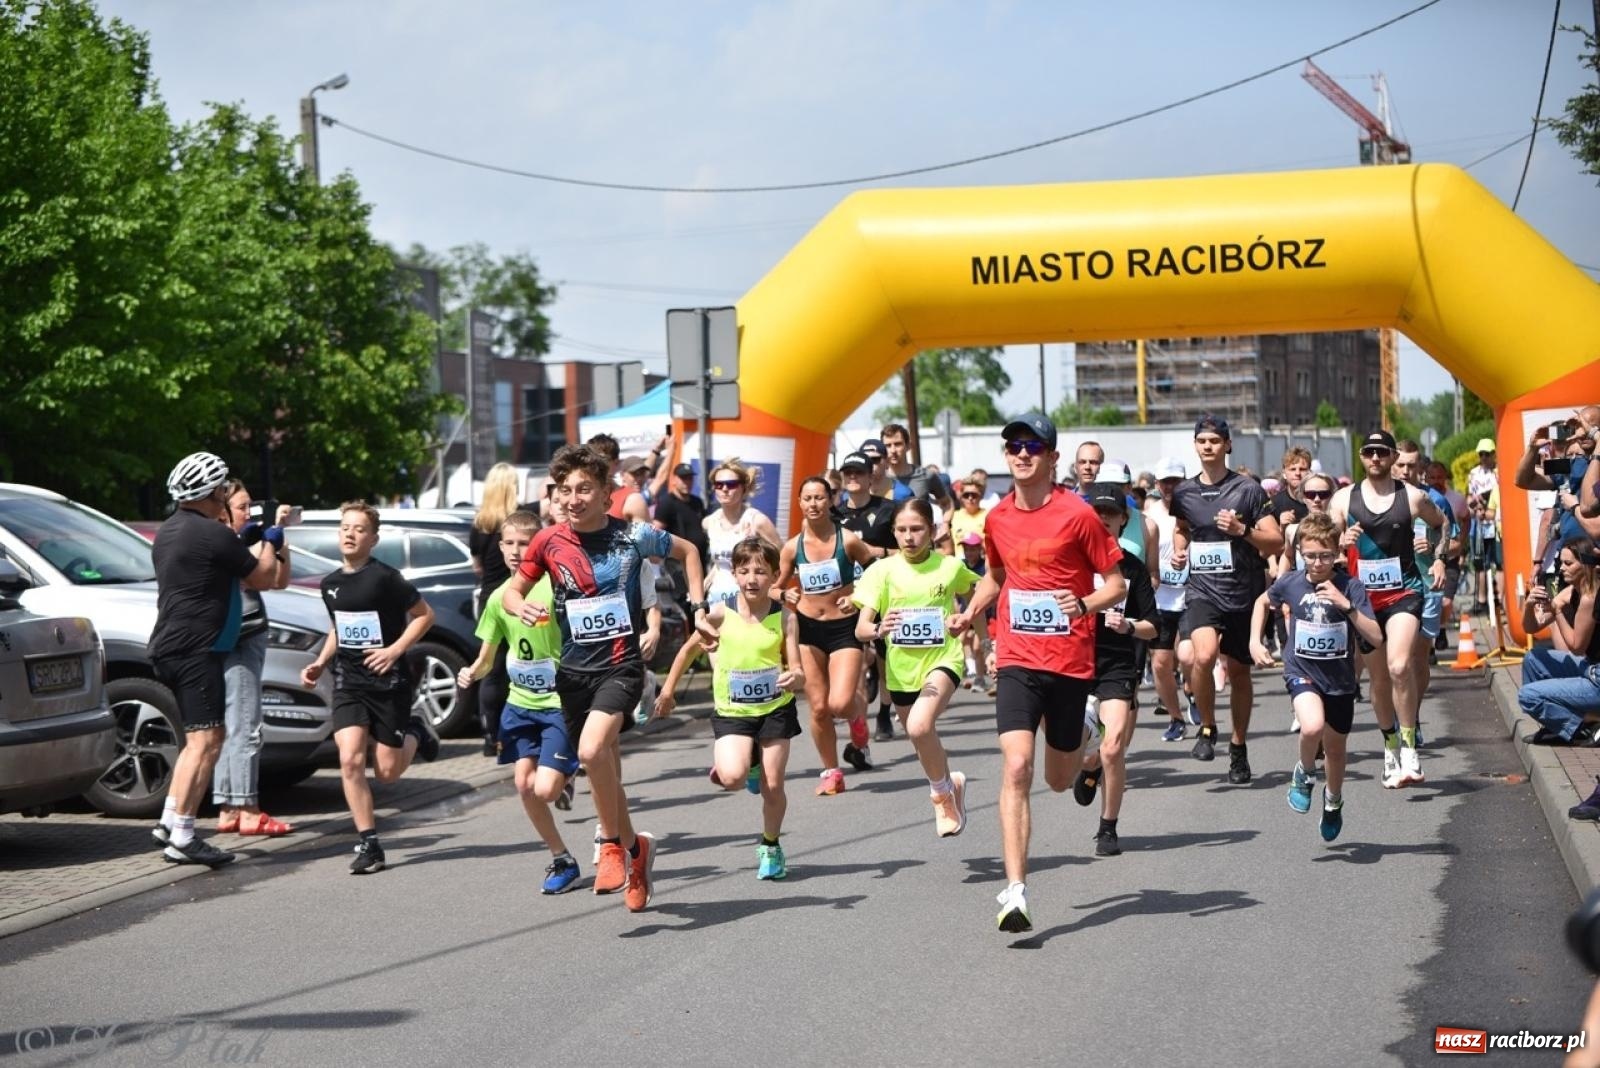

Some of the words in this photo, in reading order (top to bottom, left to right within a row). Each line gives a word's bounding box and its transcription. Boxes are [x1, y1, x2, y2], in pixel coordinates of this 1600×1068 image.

[971, 250, 1114, 285] MIASTO
[1127, 235, 1326, 278] RACIBÓRZ
[1200, 554, 1221, 565] 038
[809, 573, 830, 586] 016
[1164, 572, 1183, 581] 027
[1369, 571, 1391, 583] 041
[583, 612, 616, 630] 056
[1022, 608, 1053, 624] 039
[344, 626, 370, 639] 060
[902, 623, 932, 637] 055
[518, 637, 534, 660] 9
[1307, 637, 1336, 650] 052
[518, 673, 546, 686] 065
[743, 682, 770, 696] 061
